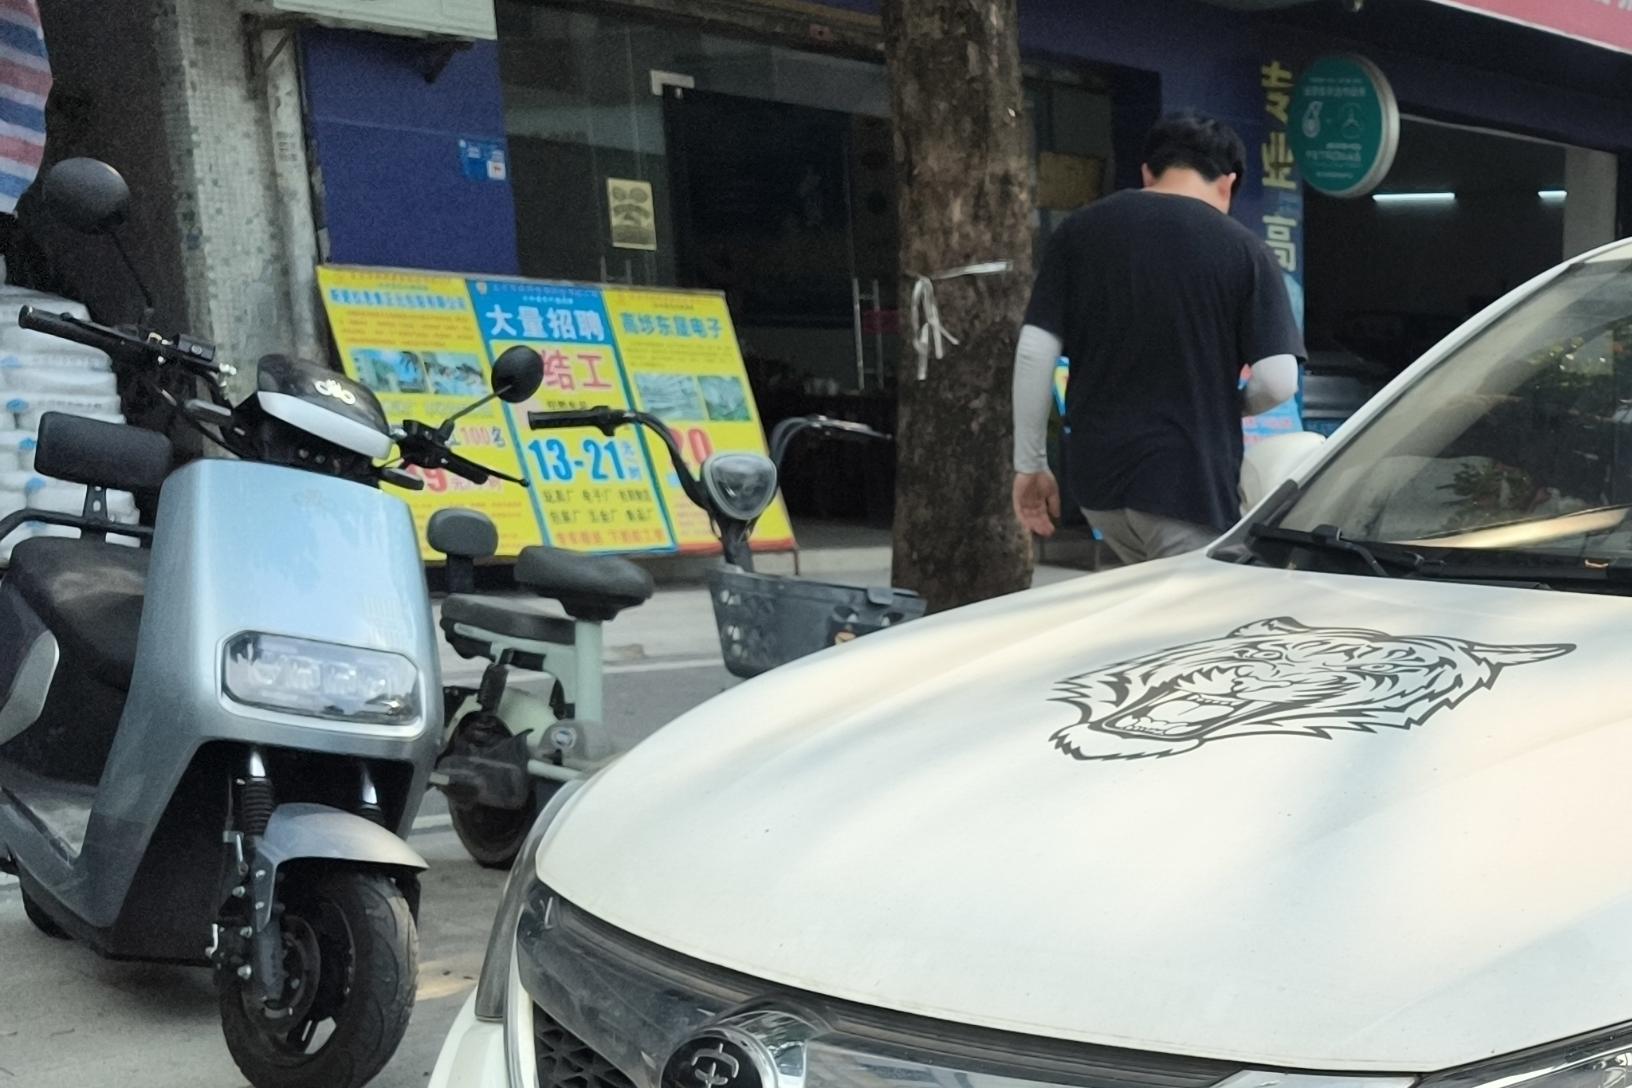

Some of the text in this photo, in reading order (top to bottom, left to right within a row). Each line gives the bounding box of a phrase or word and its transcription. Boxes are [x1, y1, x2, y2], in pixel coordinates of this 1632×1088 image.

[486, 304, 604, 341] 大量招聘
[541, 349, 612, 391] 结工
